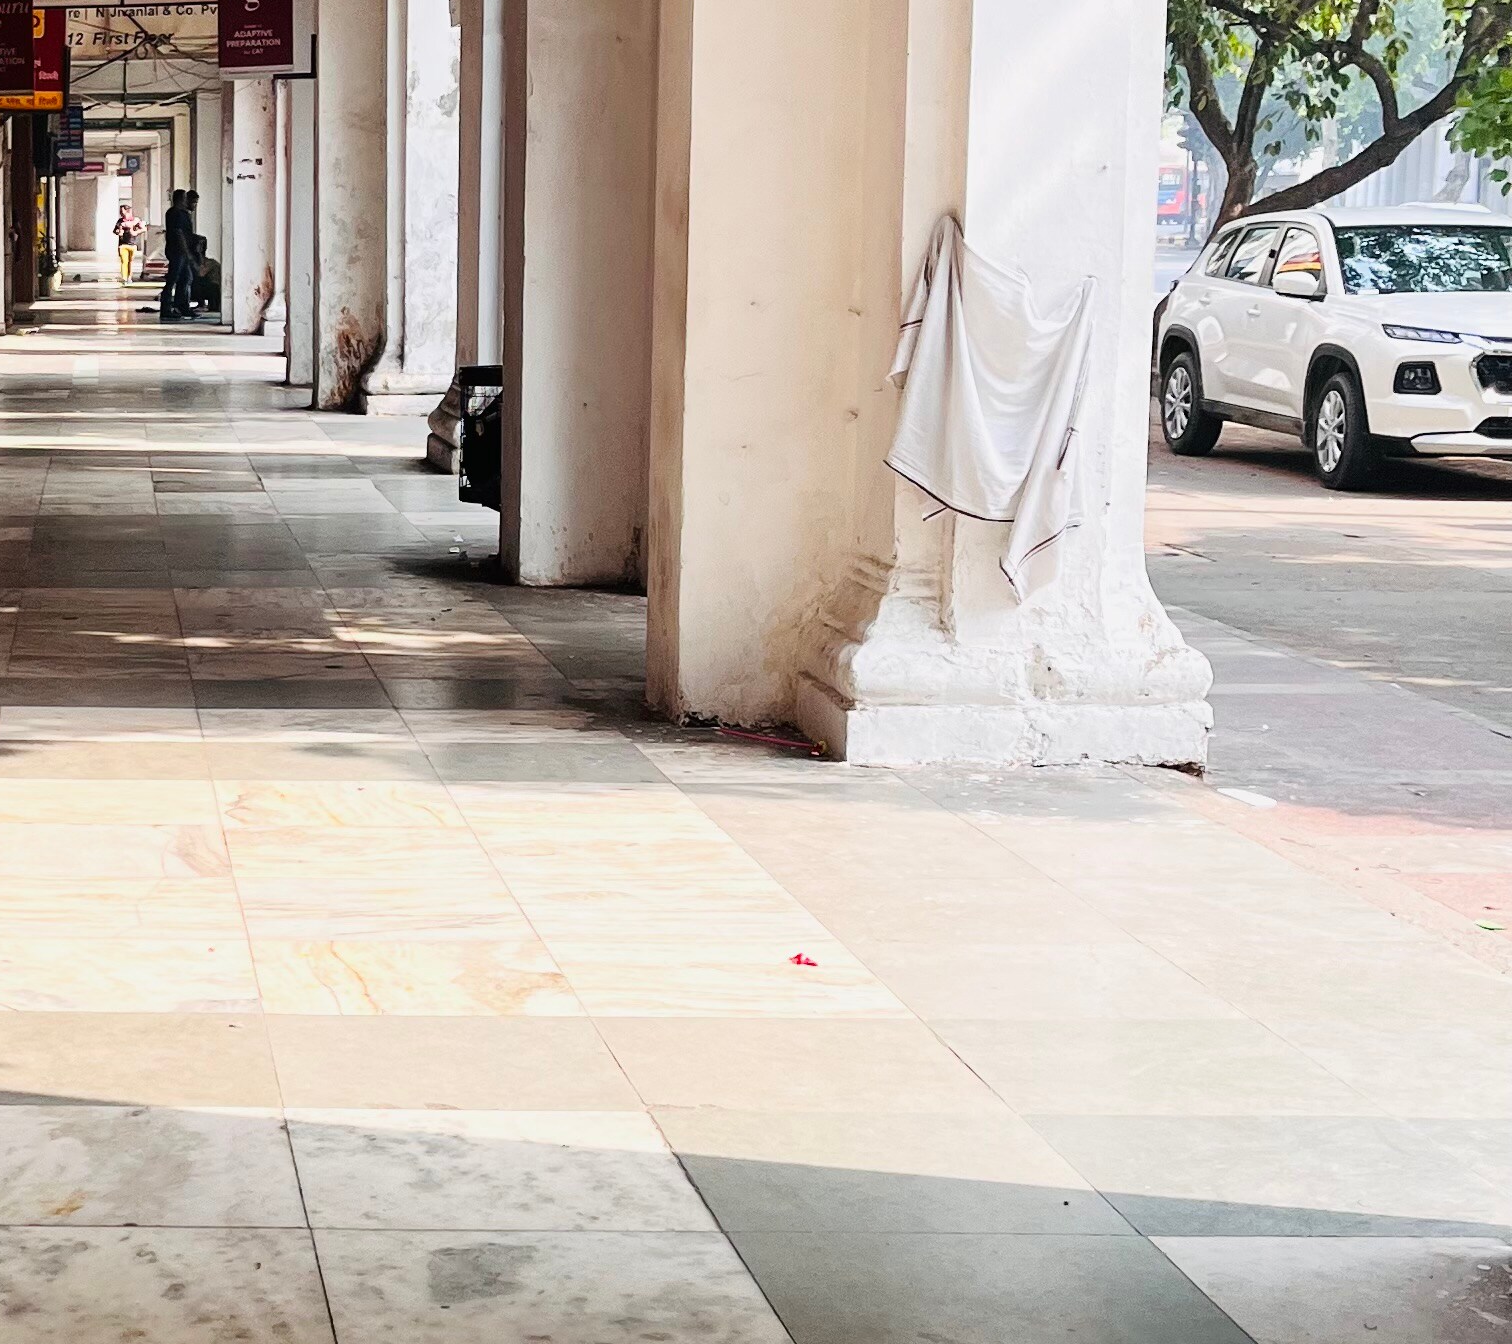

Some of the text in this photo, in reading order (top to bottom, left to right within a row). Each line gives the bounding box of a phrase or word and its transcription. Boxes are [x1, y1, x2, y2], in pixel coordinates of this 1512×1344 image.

[162, 6, 171, 16] &
[234, 28, 274, 38] ADAPTIVE
[67, 32, 84, 46] 12
[92, 32, 129, 46] First
[225, 38, 282, 48] PREPARATION
